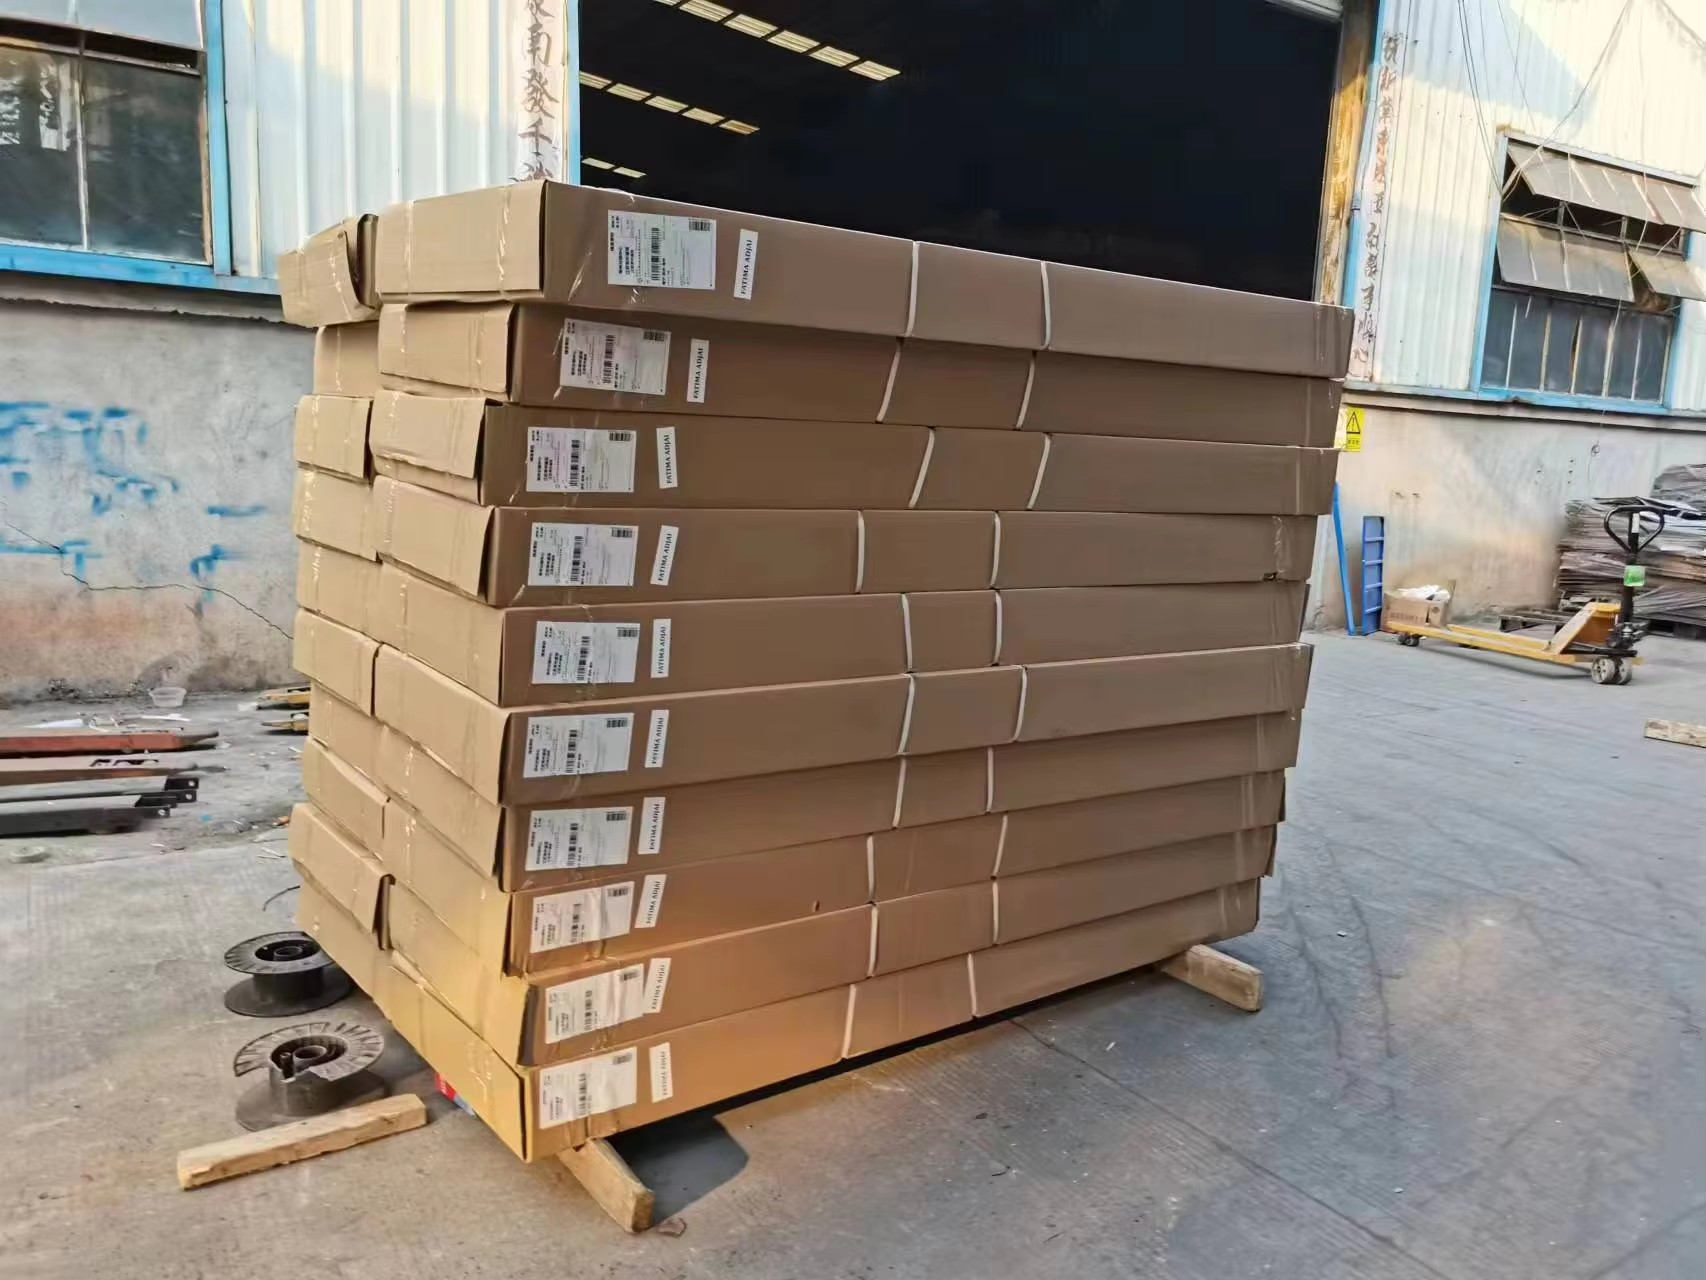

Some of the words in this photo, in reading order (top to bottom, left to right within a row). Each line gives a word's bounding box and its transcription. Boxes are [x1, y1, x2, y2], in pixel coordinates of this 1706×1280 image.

[744, 239, 753, 264] ADJAI
[741, 264, 750, 295] FATIMA
[695, 348, 704, 370] ADJAI
[693, 371, 701, 399] FATIMA
[663, 434, 671, 456] ADJAI
[664, 456, 673, 484] FATIMA
[657, 555, 668, 581] FATIMA
[663, 533, 672, 554] ADJAI
[657, 648, 665, 674] FATIMA
[651, 738, 661, 764] FATIMA
